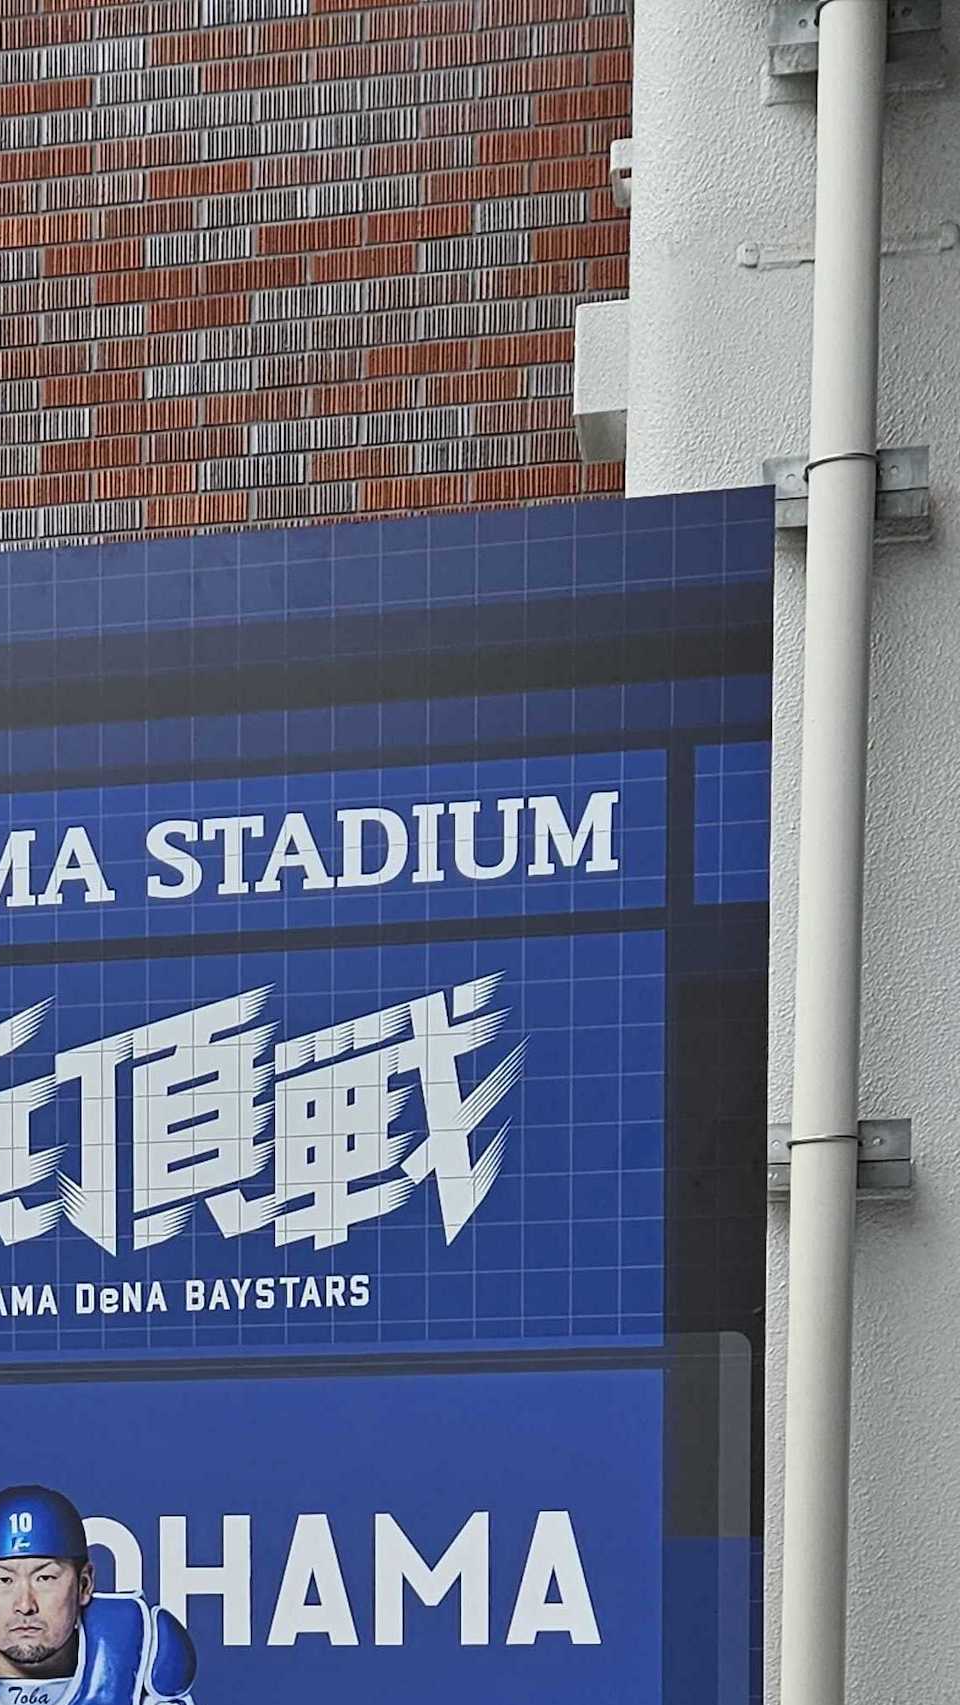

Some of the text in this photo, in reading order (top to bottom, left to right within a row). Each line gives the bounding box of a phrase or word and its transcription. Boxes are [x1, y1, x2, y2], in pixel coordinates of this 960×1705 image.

[146, 791, 619, 898] STADIUM
[76, 1281, 168, 1314] DeNA
[186, 1274, 370, 1311] BAYSTARS
[8, 1511, 33, 1534] 10
[8, 1686, 50, 1704] Toba
